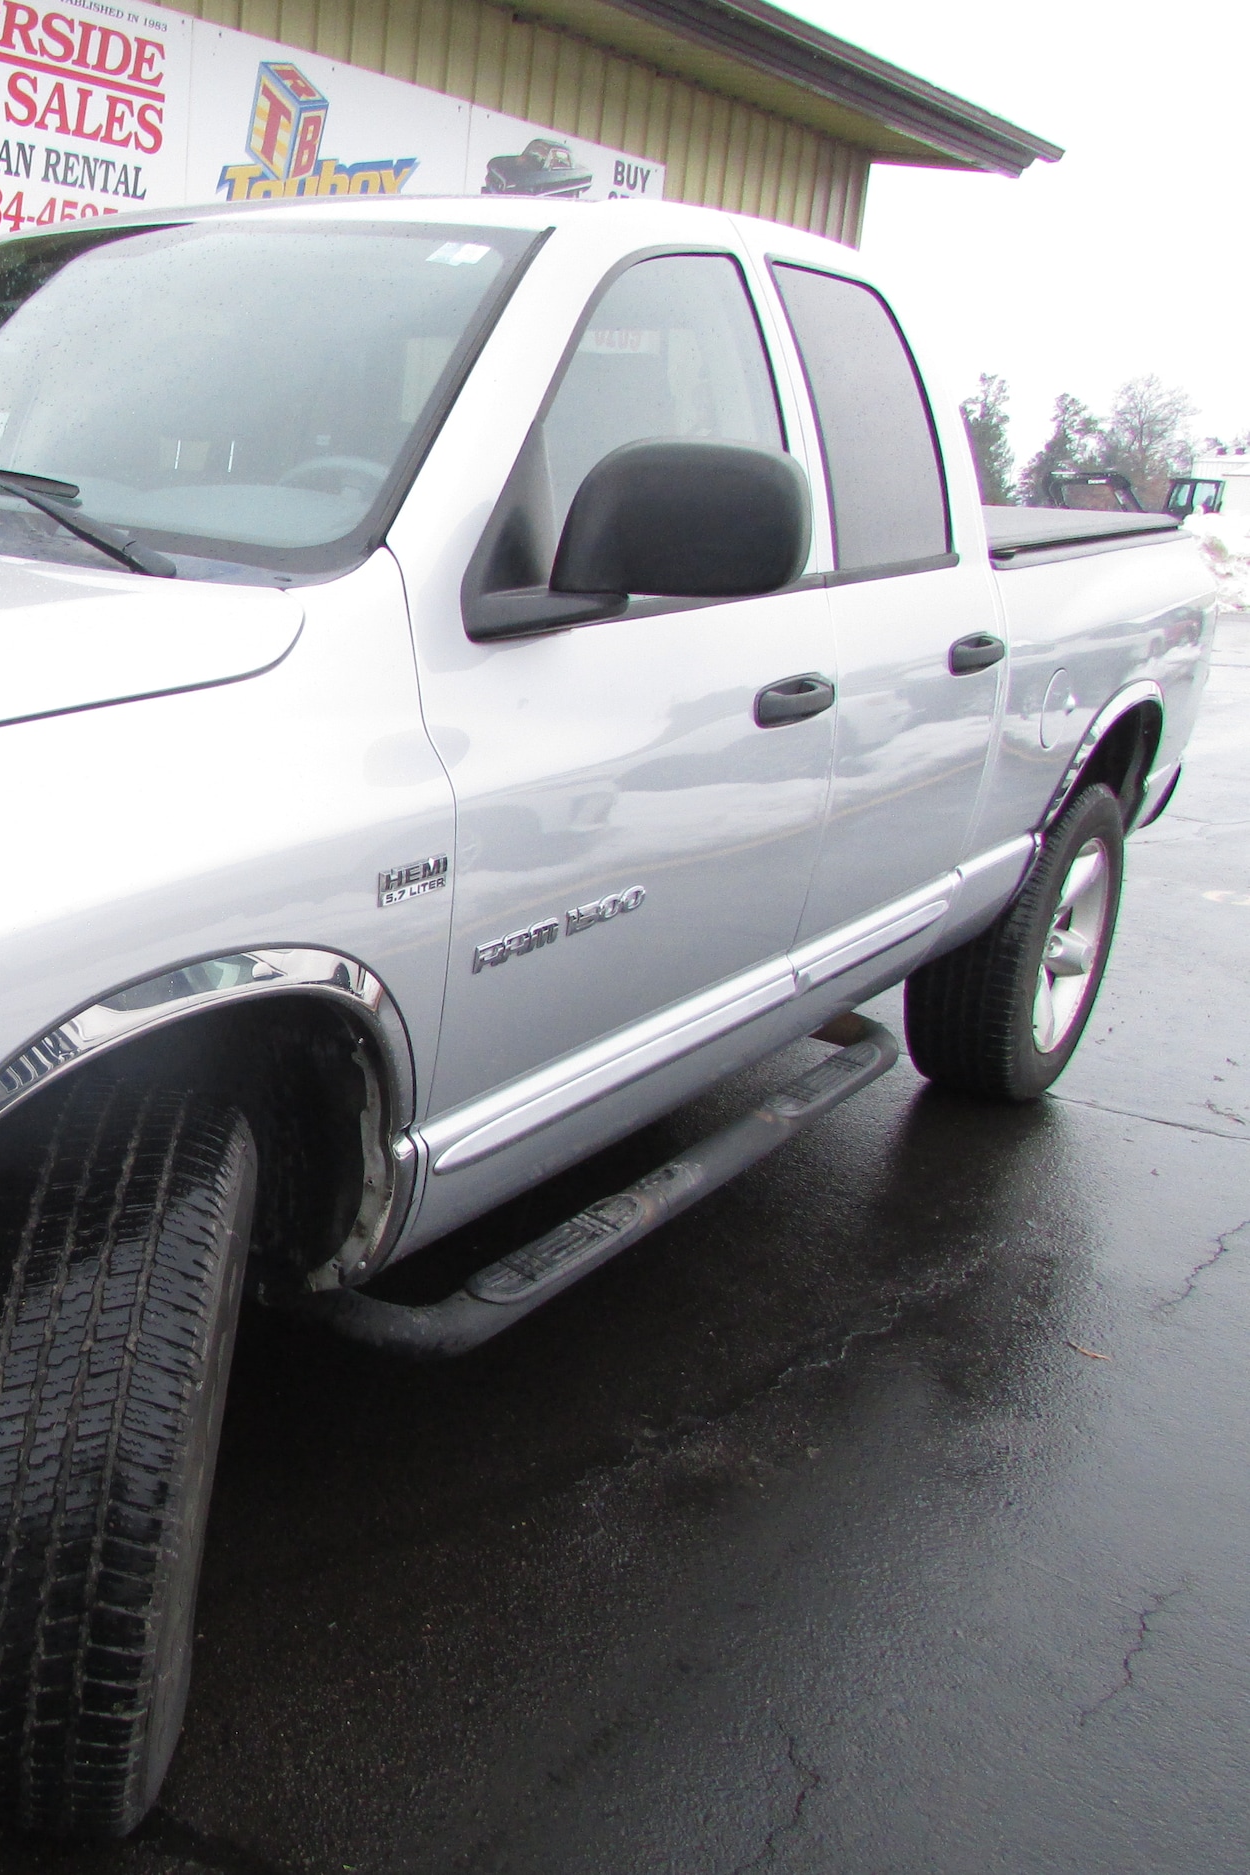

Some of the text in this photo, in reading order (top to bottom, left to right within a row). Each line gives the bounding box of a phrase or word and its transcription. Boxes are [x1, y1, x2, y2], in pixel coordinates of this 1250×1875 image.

[127, 13, 140, 23] IN
[143, 18, 168, 32] 1983
[5, 71, 164, 154] SALES
[41, 147, 148, 200] RENTAL
[613, 160, 650, 194] BUY
[380, 854, 448, 891] HEMI
[385, 877, 446, 904] 5.7 LITER
[565, 885, 646, 936] 1500
